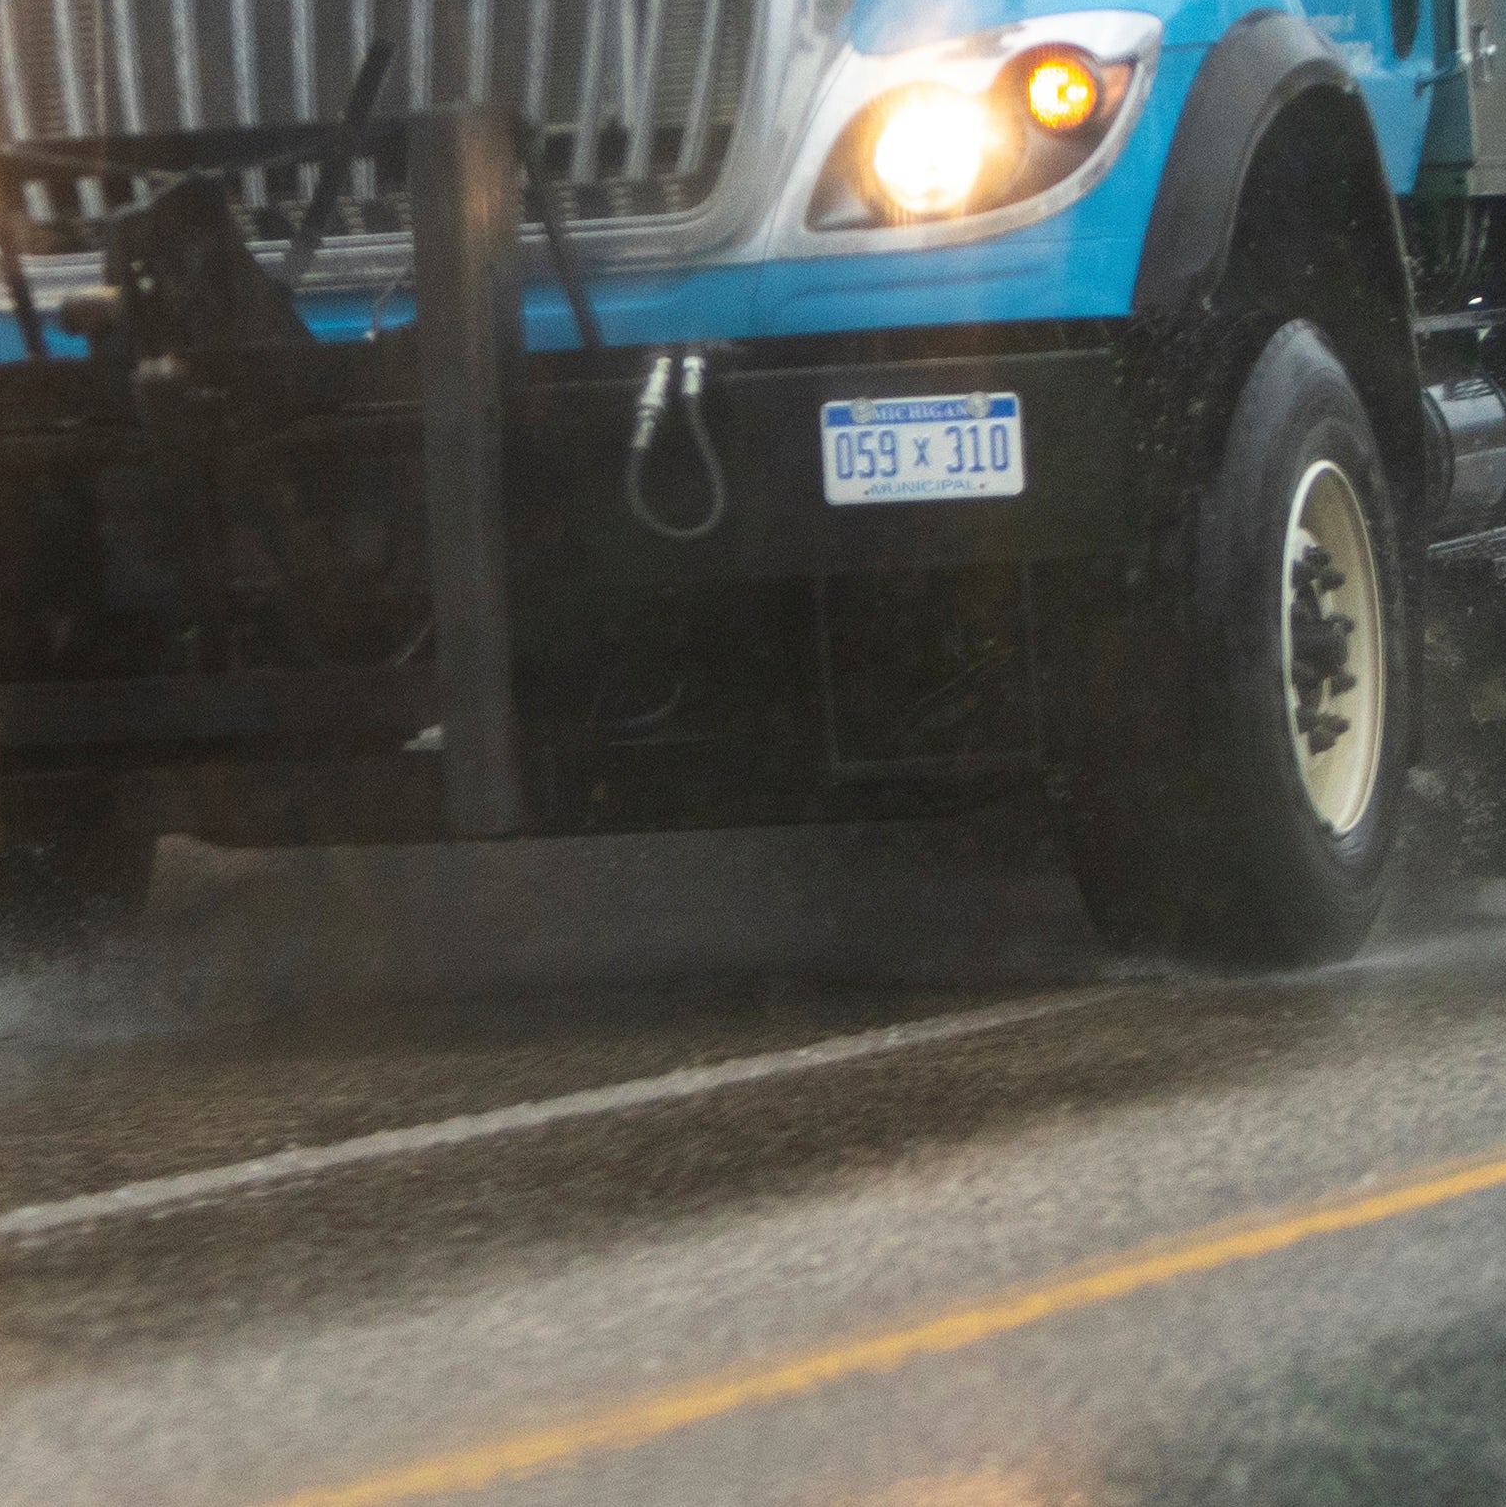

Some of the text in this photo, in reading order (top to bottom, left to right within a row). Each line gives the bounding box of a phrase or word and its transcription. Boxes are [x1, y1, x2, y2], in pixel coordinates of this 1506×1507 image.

[874, 403, 967, 420] MICHIGAN
[836, 430, 896, 479] 059
[945, 424, 1009, 472] 310
[870, 480, 971, 494] MUNICIPAL
